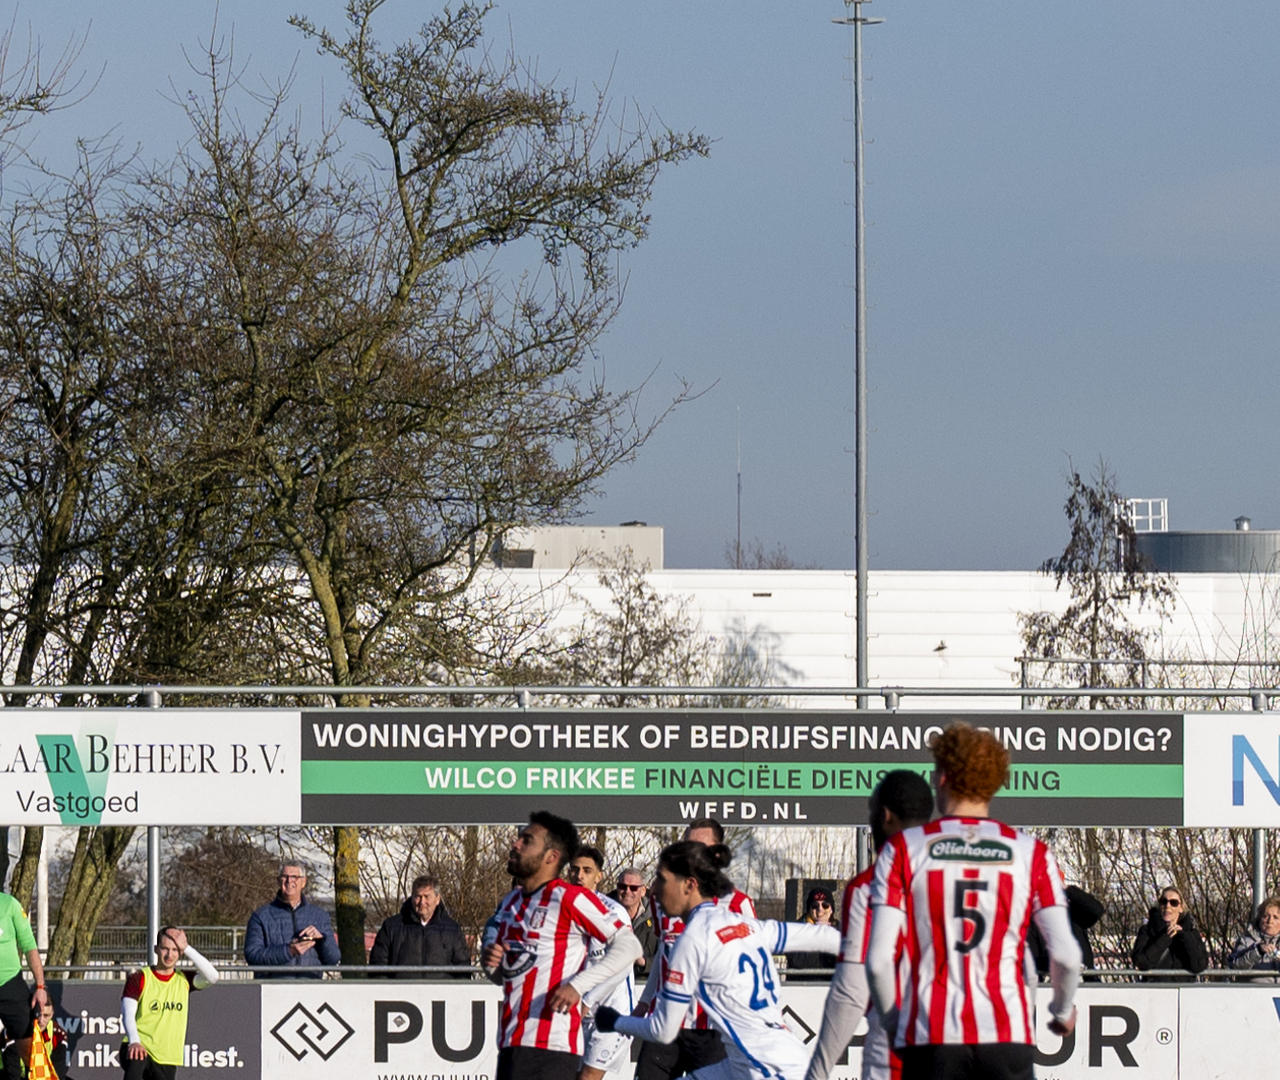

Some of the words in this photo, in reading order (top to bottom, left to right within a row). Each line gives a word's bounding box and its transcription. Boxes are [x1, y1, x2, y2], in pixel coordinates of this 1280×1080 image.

[313, 723, 630, 749] WONINGHYPOTHEEK
[639, 725, 680, 750] OF
[1057, 727, 1172, 752] NODIG?
[231, 743, 286, 774] B.V.
[425, 768, 518, 790] WILCO
[525, 768, 635, 790] FRIKKEE
[645, 764, 803, 790] FINANCIËLE
[17, 789, 139, 817] Vastgoed
[932, 841, 1009, 860] Oliehoorn
[953, 879, 989, 955] 5
[162, 1001, 183, 1012] JAKO
